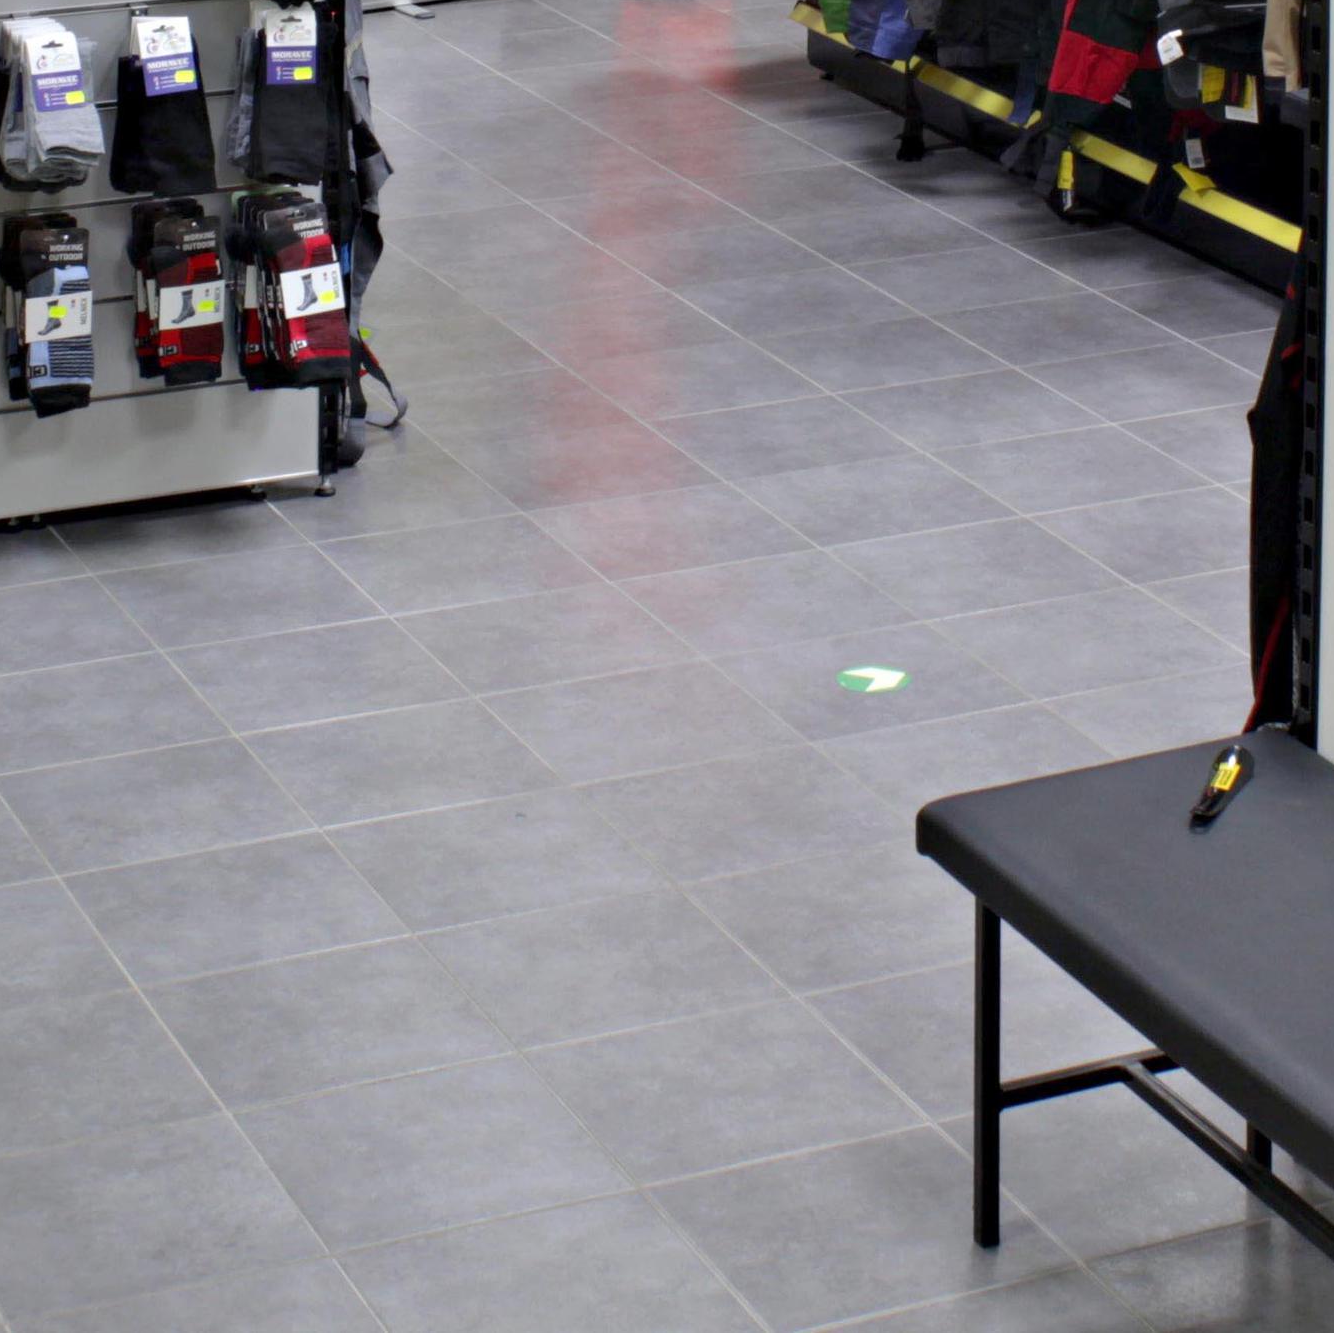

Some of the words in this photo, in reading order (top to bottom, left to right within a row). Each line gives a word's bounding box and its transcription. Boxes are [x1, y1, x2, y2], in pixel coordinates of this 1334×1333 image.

[183, 231, 217, 242] WORKING
[49, 243, 83, 253] WORKING
[182, 240, 216, 251] OUTDOOR
[48, 252, 83, 262] OUTDOOR
